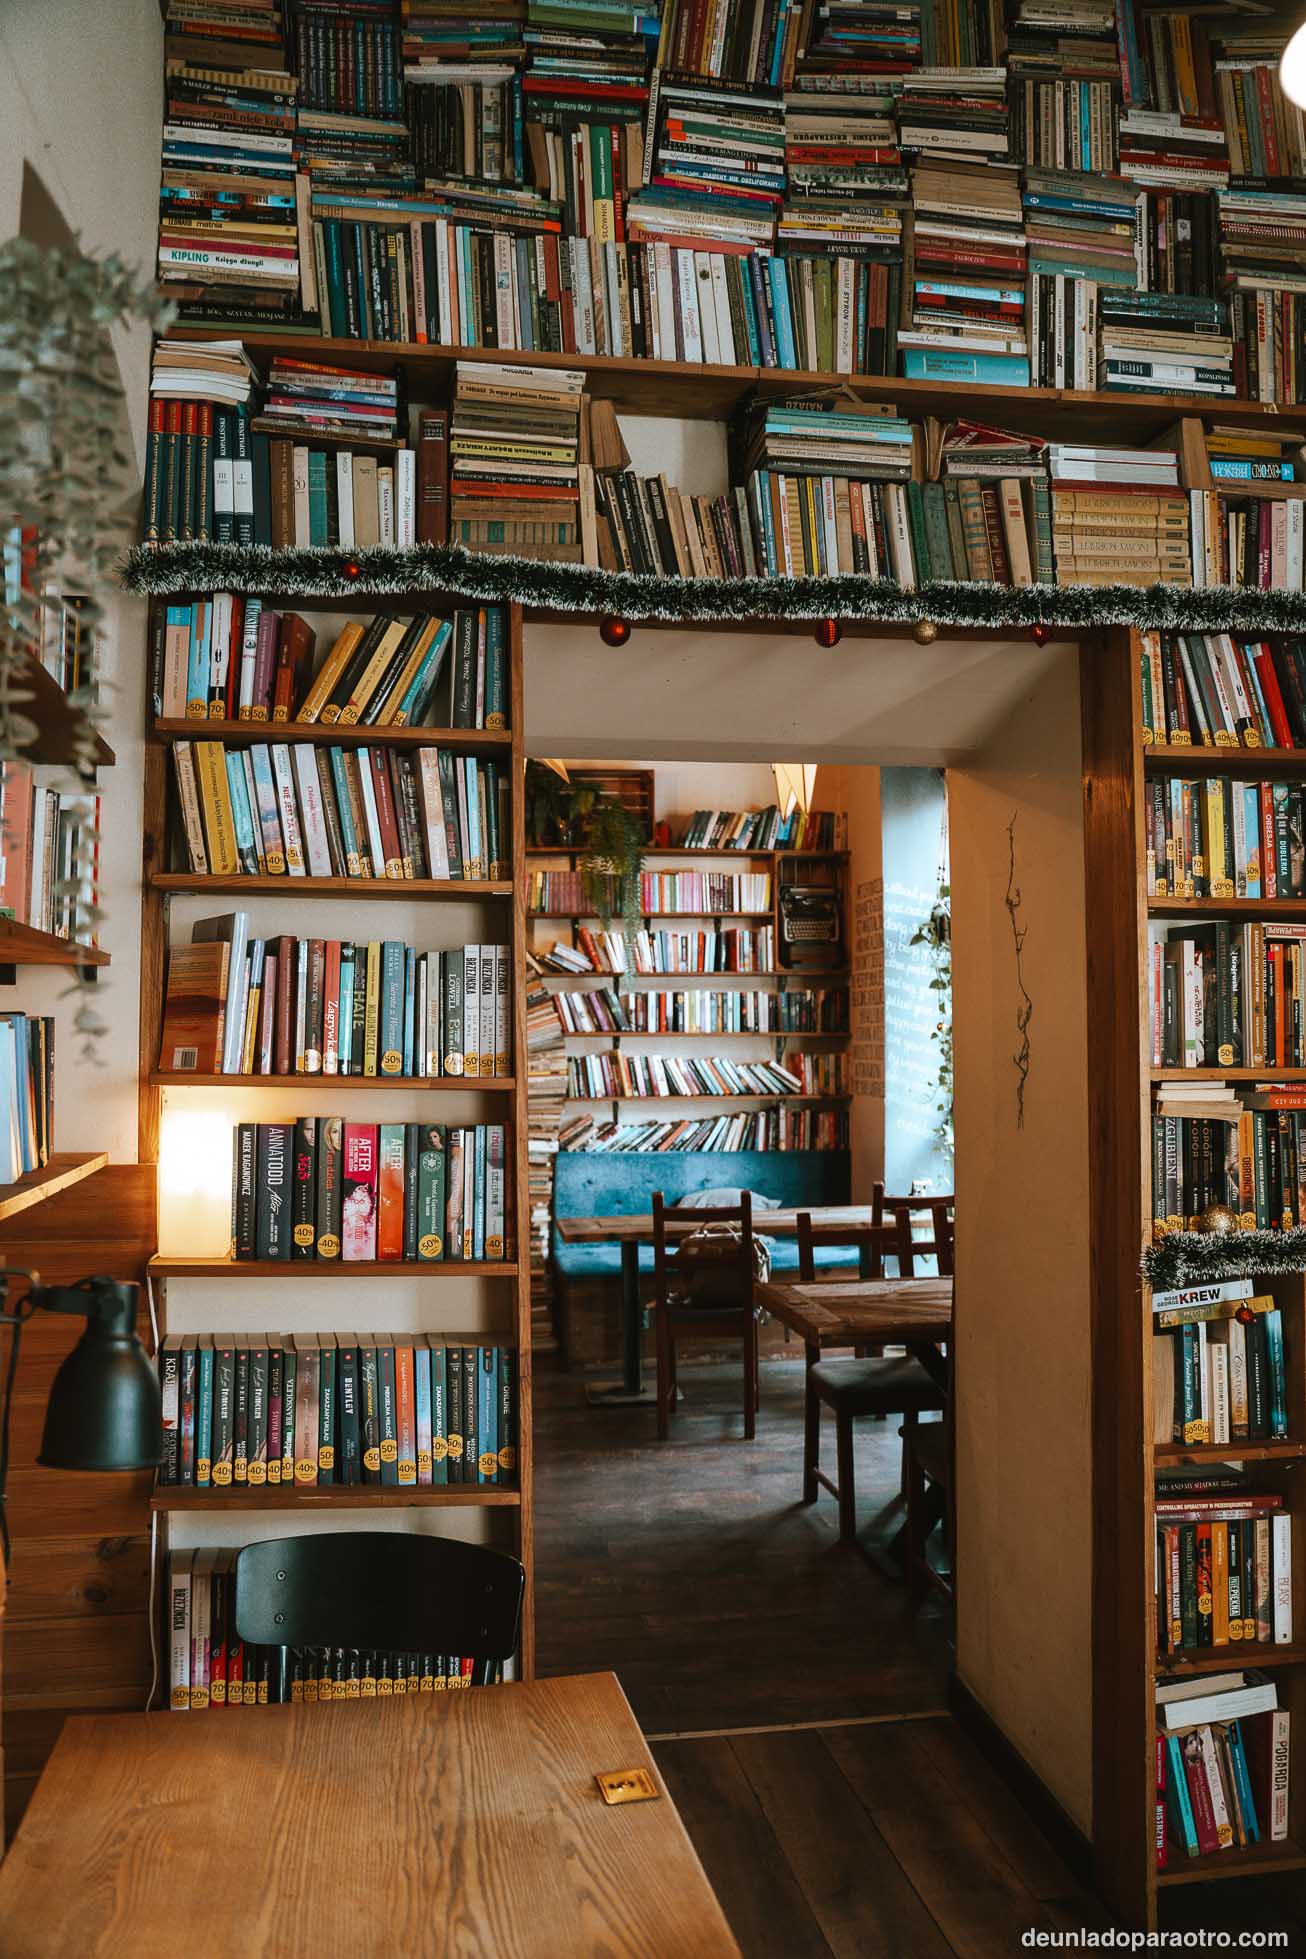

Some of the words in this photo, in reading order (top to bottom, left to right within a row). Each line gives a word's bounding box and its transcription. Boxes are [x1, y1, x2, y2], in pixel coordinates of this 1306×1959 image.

[601, 202, 609, 240] SŁOWNIK
[171, 250, 209, 263] KIPLING
[215, 255, 238, 266] Księga
[240, 257, 265, 268] dżungli
[218, 417, 226, 457] KOPALIŃSKI
[237, 418, 246, 458] KOPALIŃSKI
[1214, 466, 1248, 479] FRENCH
[1252, 463, 1280, 479] OXFORD
[382, 488, 391, 512] MANNA
[244, 606, 260, 636] FORSYTH
[282, 785, 291, 799] NIE
[284, 800, 294, 817] JEST
[213, 799, 223, 827] leksykon
[1264, 814, 1274, 849] OBSESJA
[1279, 840, 1288, 877] DUBLERKA
[448, 973, 457, 1011] LOWELL
[465, 957, 478, 995] BRZEZIŃSKA
[481, 958, 494, 996] BRZEZIŃSKA
[326, 999, 339, 1053] Zagrywka
[353, 990, 365, 1030] HATE
[241, 1130, 252, 1154] MAREK
[358, 1137, 371, 1172] AFTER
[390, 1137, 403, 1170] AFTER
[1165, 1118, 1177, 1180] ZGUBIENI
[241, 1153, 252, 1197] RAGANOWICZ
[431, 1179, 440, 1198] Dorota
[1242, 1156, 1253, 1195] OBROŃCY
[265, 1185, 283, 1217] After
[430, 1198, 440, 1234] Gąsiorowska
[1157, 1299, 1179, 1308] GEORGE
[1178, 1288, 1222, 1305] KREW
[285, 1378, 295, 1426] BRANSOLETA
[323, 1387, 331, 1420] ZAKAZANY
[344, 1377, 354, 1415] BENTLEY
[384, 1385, 392, 1416] PIEKIELNA
[435, 1385, 443, 1417] ZAKAZANY
[503, 1385, 511, 1415] ONLINE
[323, 1420, 331, 1442] UKŁAD
[384, 1416, 393, 1439] MIŁOŚĆ
[435, 1417, 443, 1438] UKŁAD
[1274, 1740, 1288, 1791] POGARDA
[1155, 1805, 1165, 1849] MISTRZYNI
